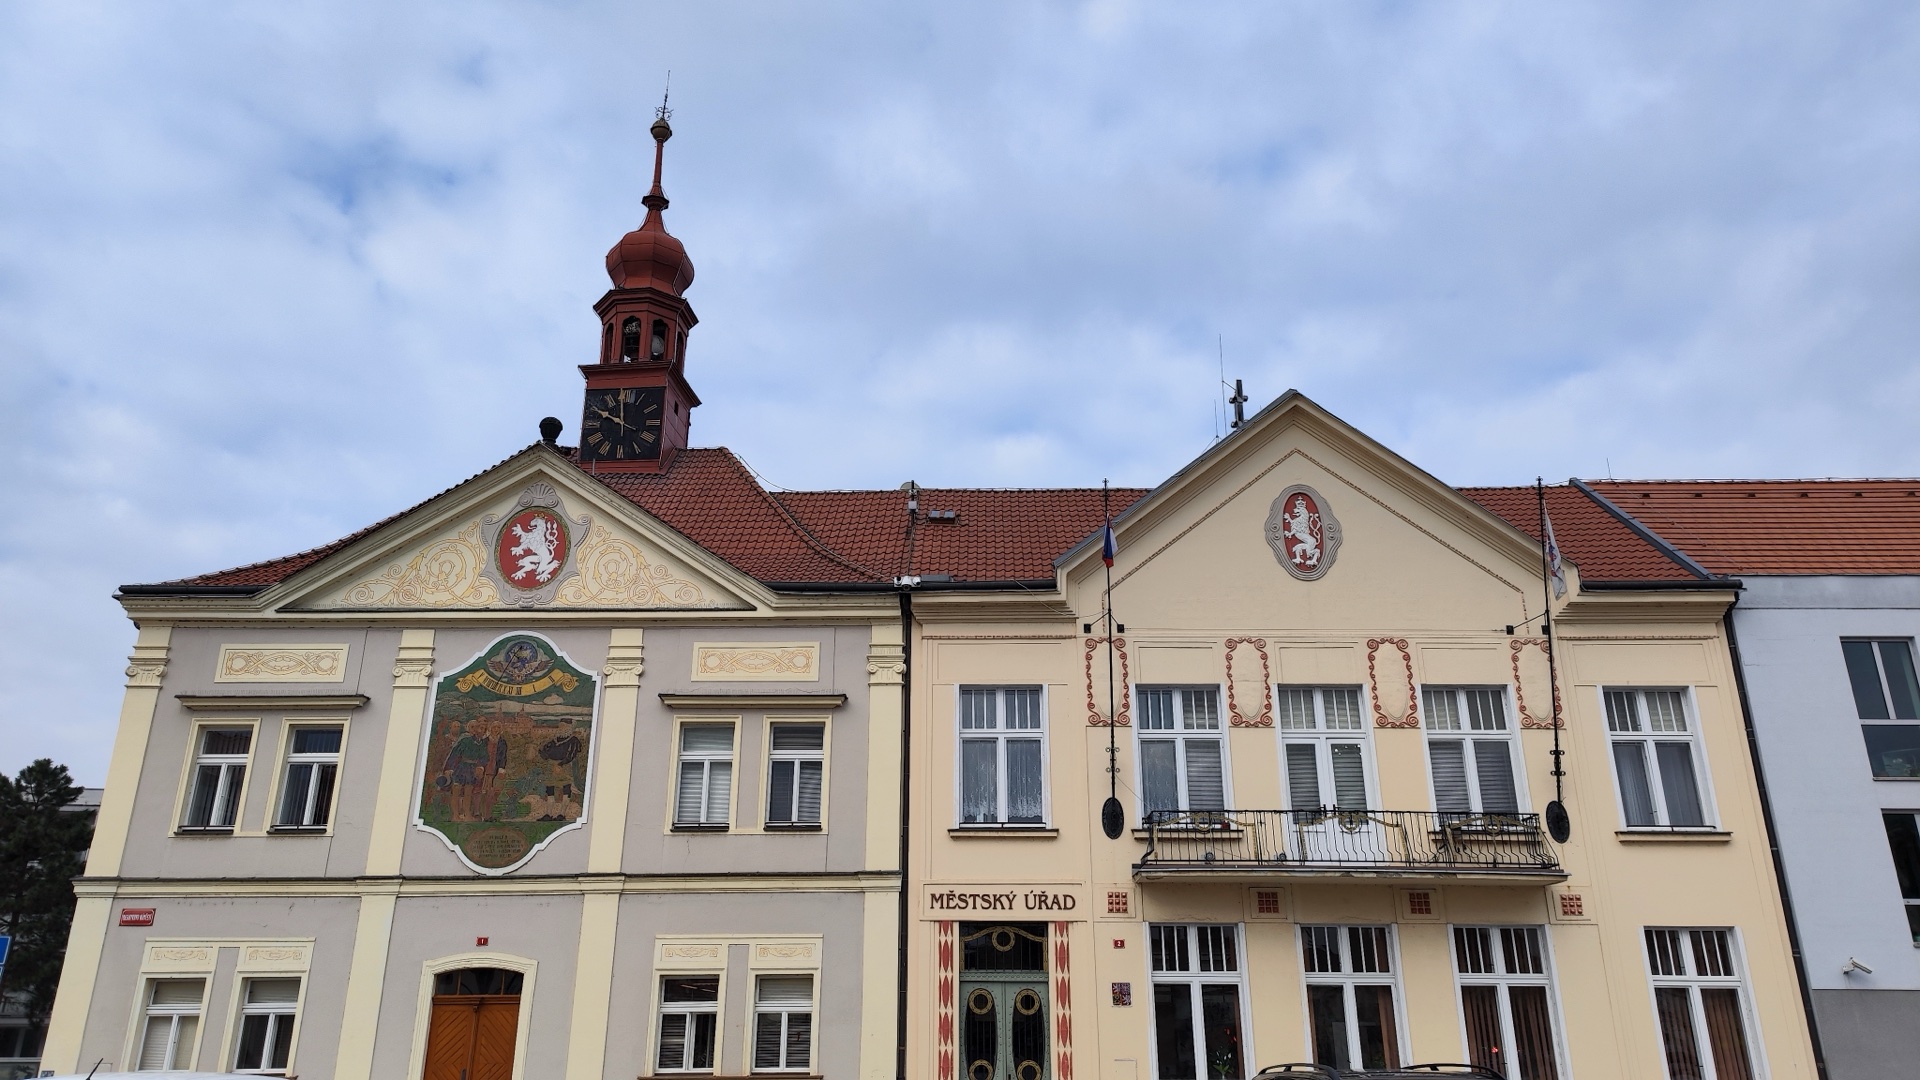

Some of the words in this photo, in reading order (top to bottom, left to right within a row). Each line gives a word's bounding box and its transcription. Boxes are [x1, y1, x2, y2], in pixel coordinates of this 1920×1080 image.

[643, 404, 658, 414] II
[930, 890, 1017, 910] MĚSTSKÝ
[1024, 890, 1076, 910] ÚŘAD
